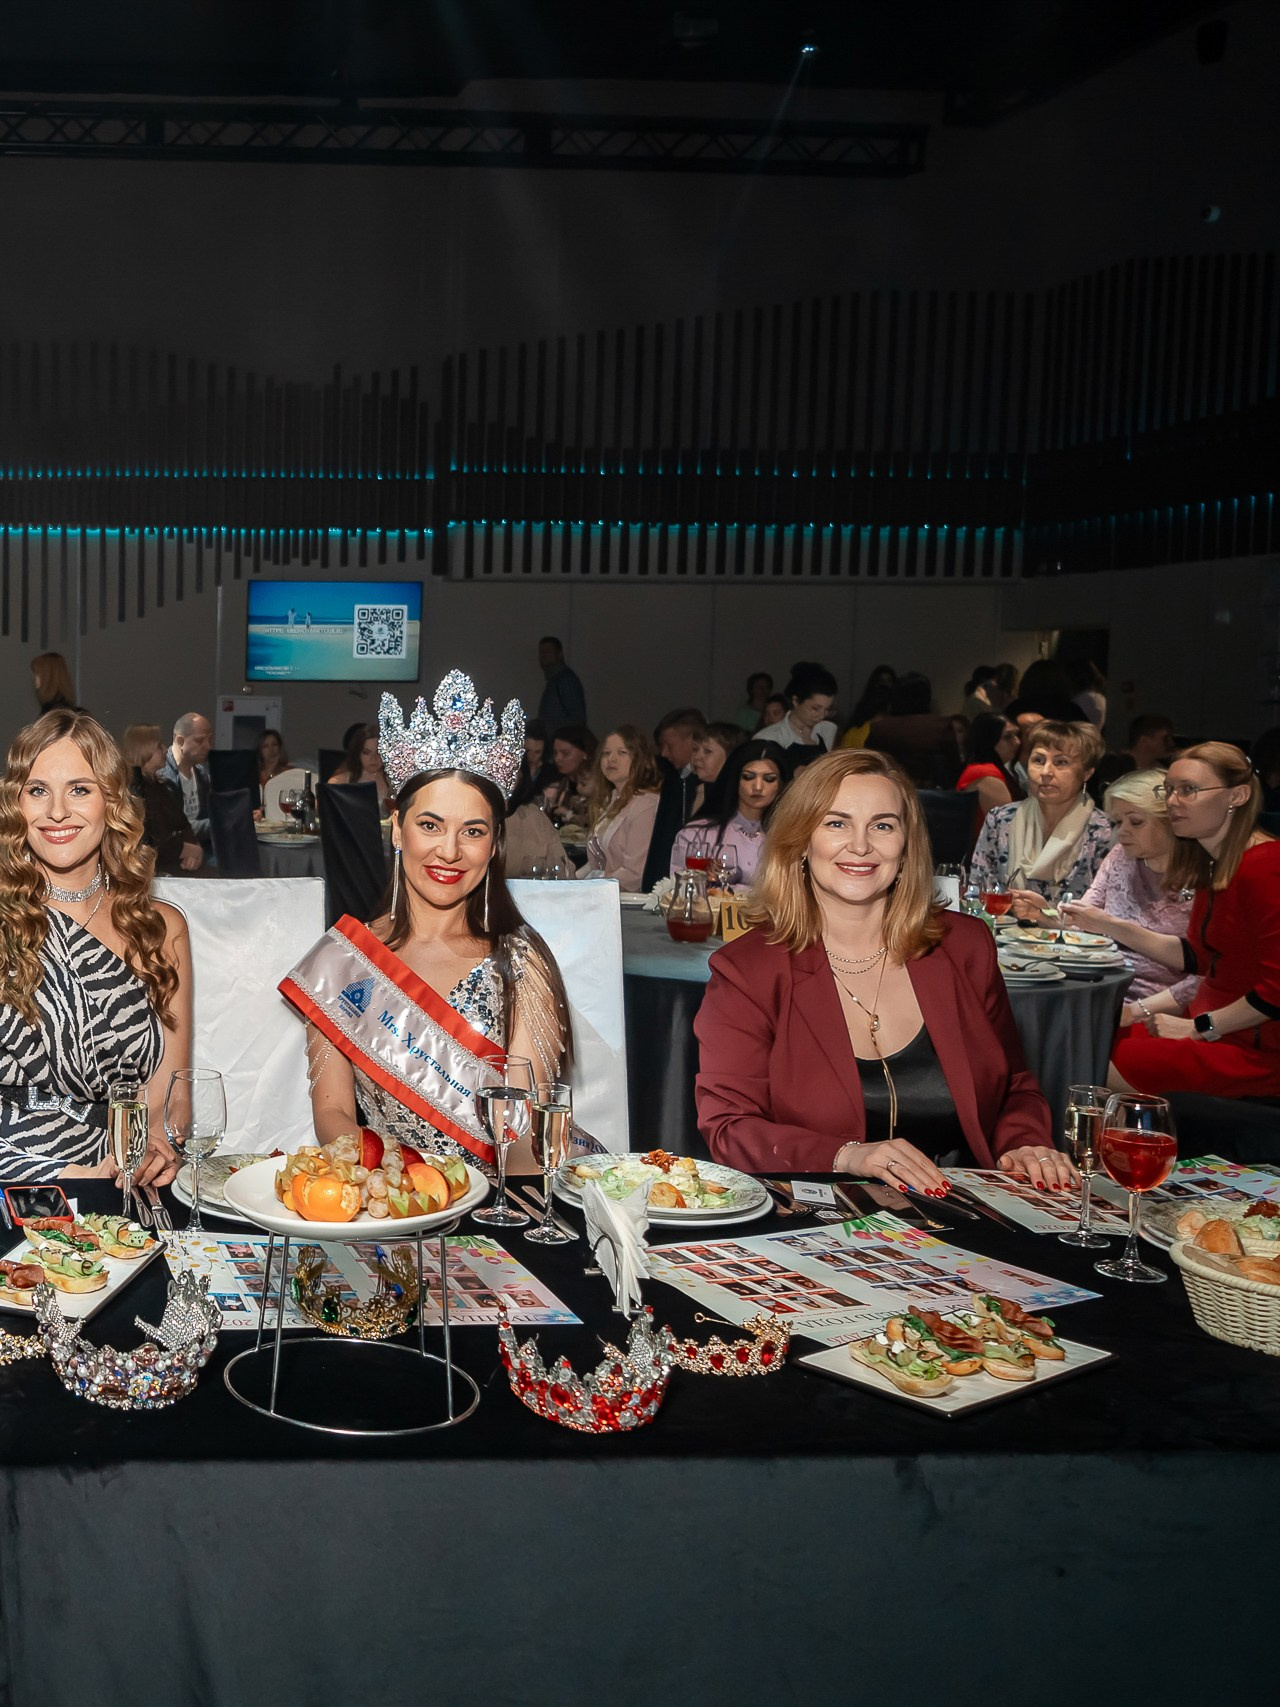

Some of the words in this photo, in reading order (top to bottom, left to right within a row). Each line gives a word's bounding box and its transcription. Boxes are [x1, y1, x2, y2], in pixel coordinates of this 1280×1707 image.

[377, 1010, 399, 1037] Mrs.
[402, 1032, 472, 1098] Хрустальная
[222, 1319, 255, 1327] 202
[797, 1316, 856, 1329] ГОДА
